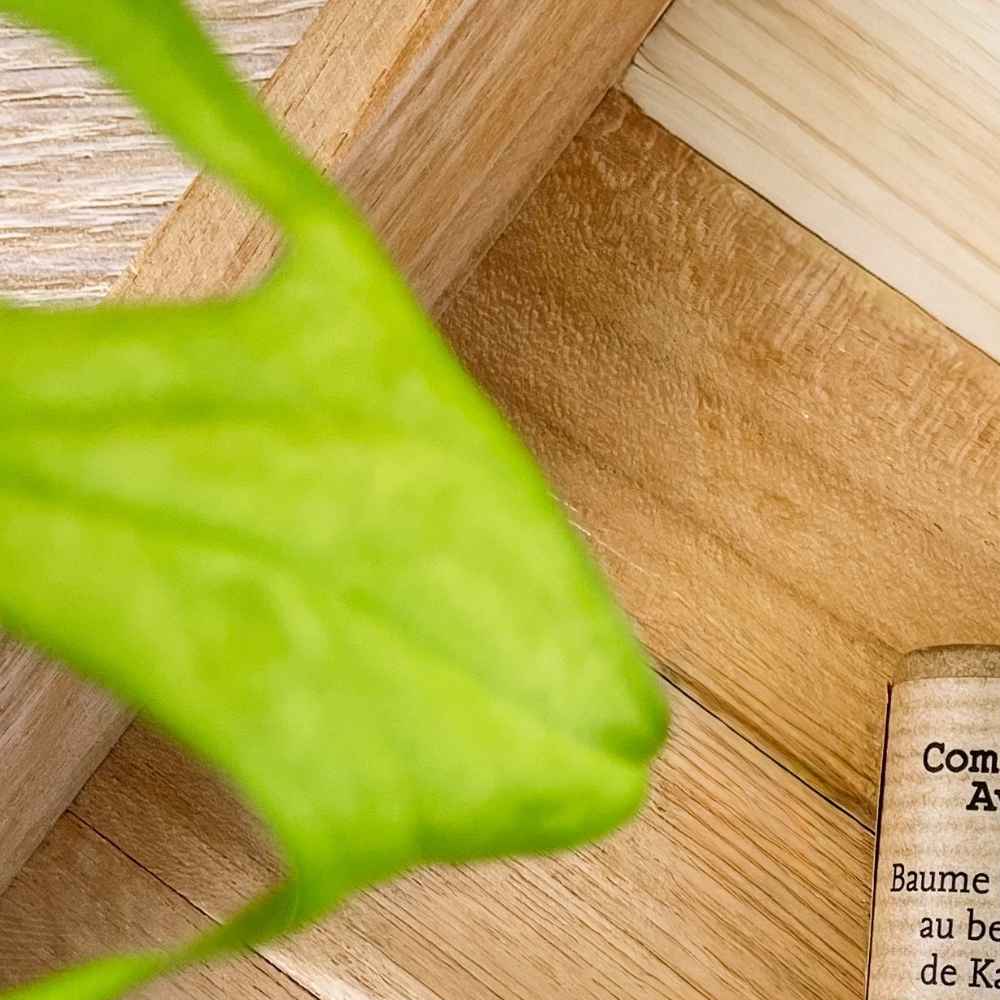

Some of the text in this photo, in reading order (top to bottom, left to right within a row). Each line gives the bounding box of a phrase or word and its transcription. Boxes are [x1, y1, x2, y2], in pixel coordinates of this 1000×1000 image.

[889, 863, 990, 894] Baume
[920, 917, 954, 939] au
[920, 953, 957, 986] de
